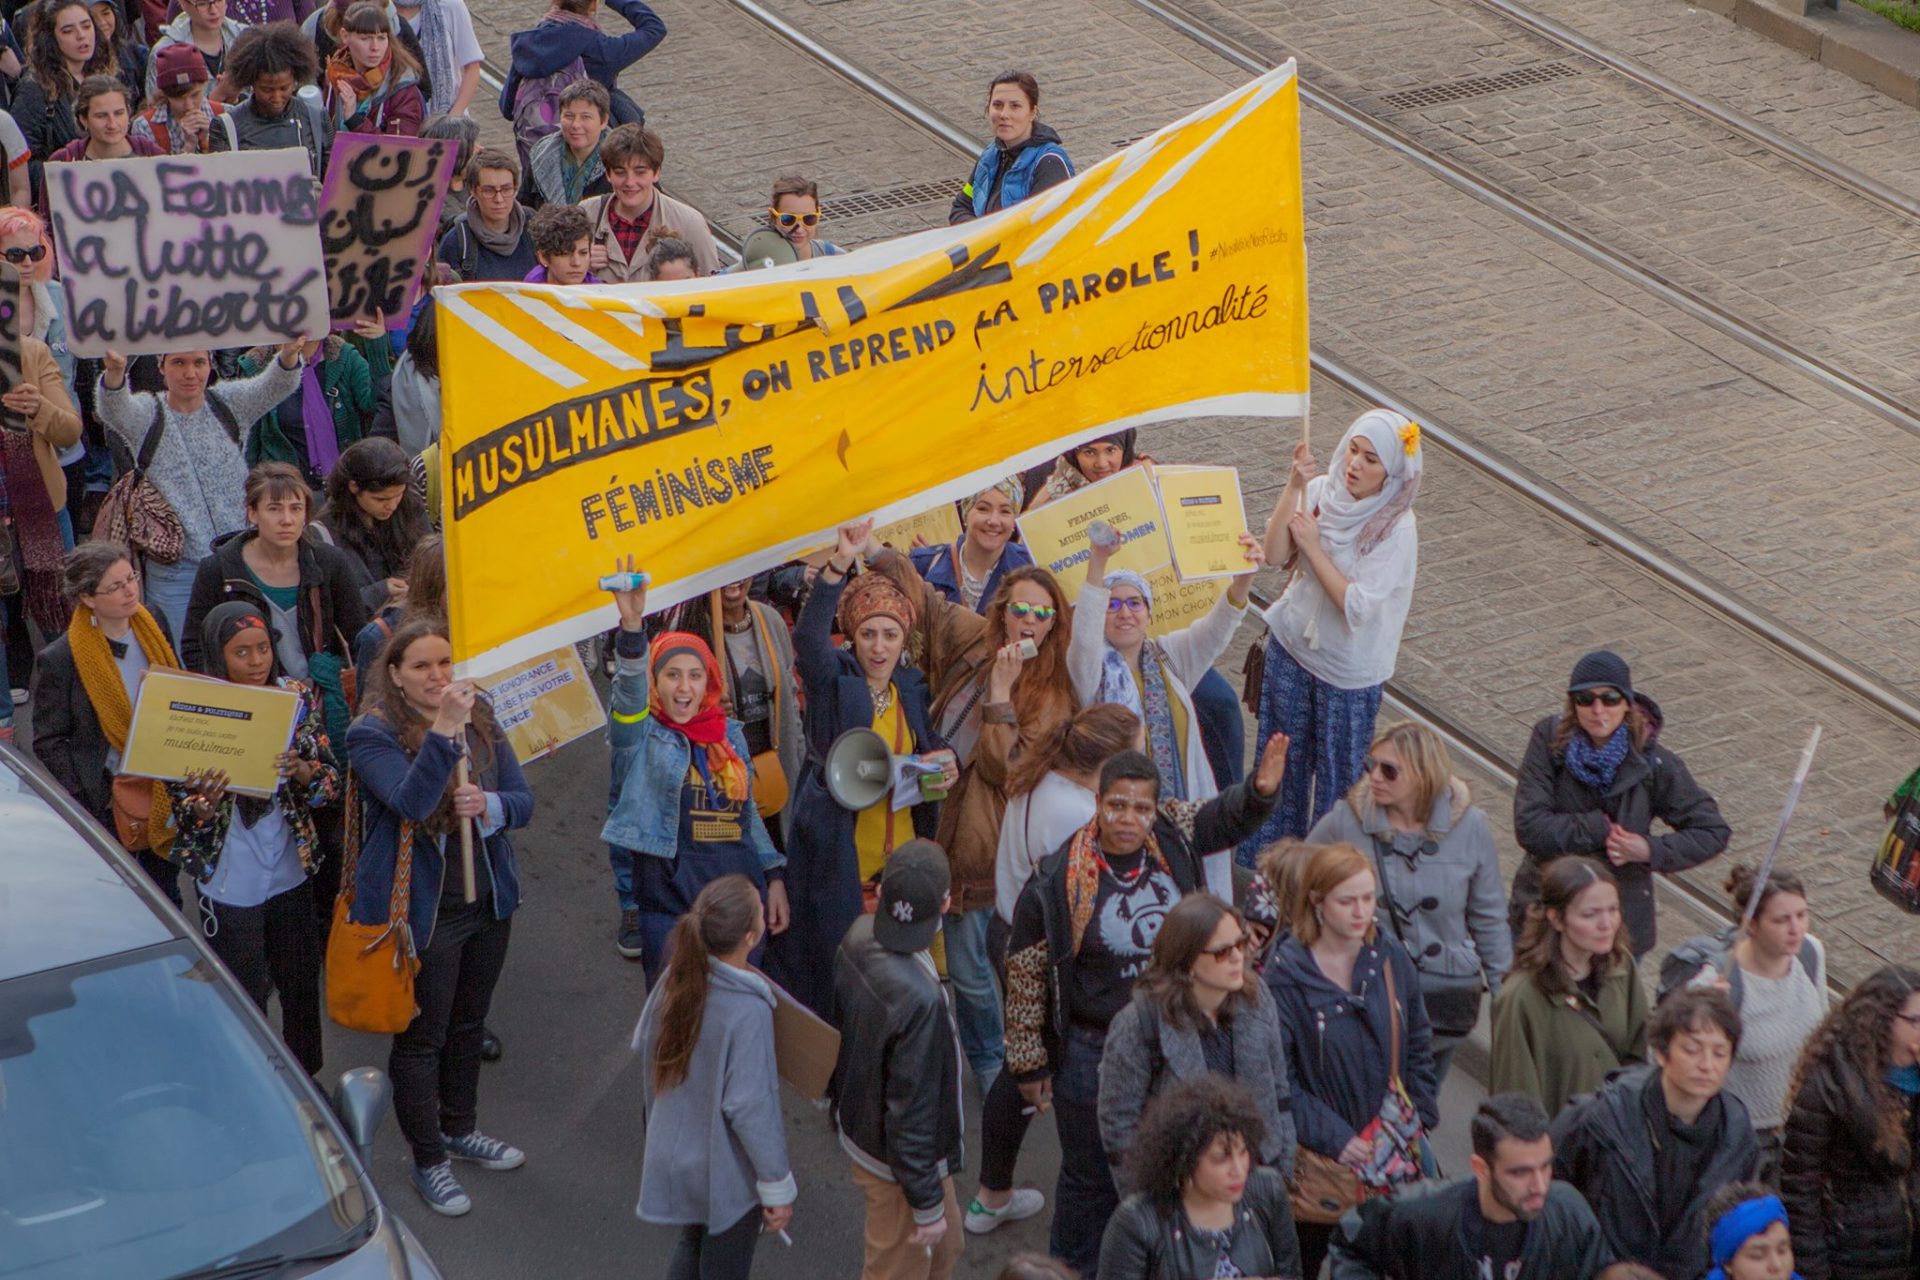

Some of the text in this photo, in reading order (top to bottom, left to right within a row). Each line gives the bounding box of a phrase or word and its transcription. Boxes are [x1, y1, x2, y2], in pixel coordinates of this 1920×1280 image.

[54, 212, 281, 282] la lutte
[62, 267, 320, 344] la liberté
[742, 360, 792, 401] ON
[807, 318, 955, 383] REPREND
[1037, 251, 1174, 314] PAROLE
[970, 284, 1269, 412] intersectionnalité
[581, 444, 775, 540] FÉMINISME
[1067, 504, 1111, 528] FEMMES
